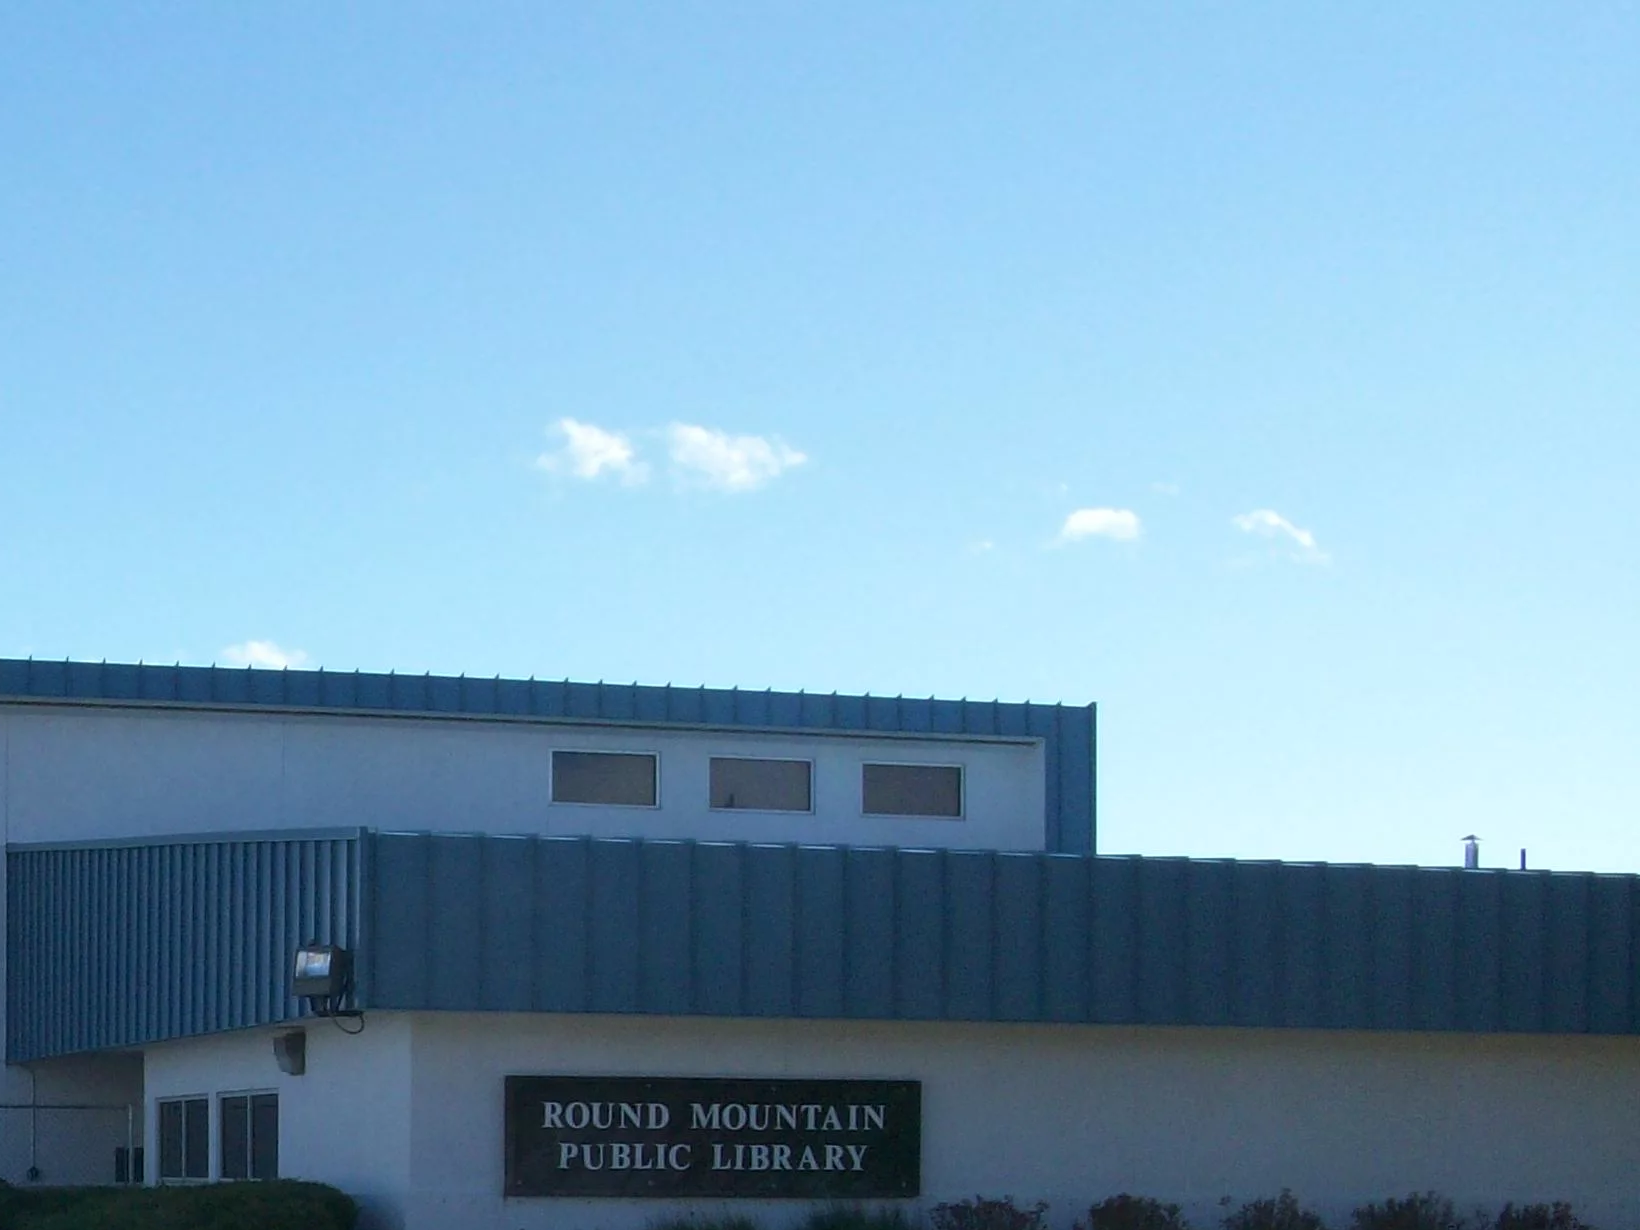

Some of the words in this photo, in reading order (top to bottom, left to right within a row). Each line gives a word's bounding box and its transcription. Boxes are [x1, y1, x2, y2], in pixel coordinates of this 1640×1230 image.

[541, 1101, 670, 1129] ROUND
[690, 1103, 885, 1131] MOUNTAIN
[557, 1142, 691, 1170] PUBLIC
[712, 1144, 868, 1171] LIBRARY
